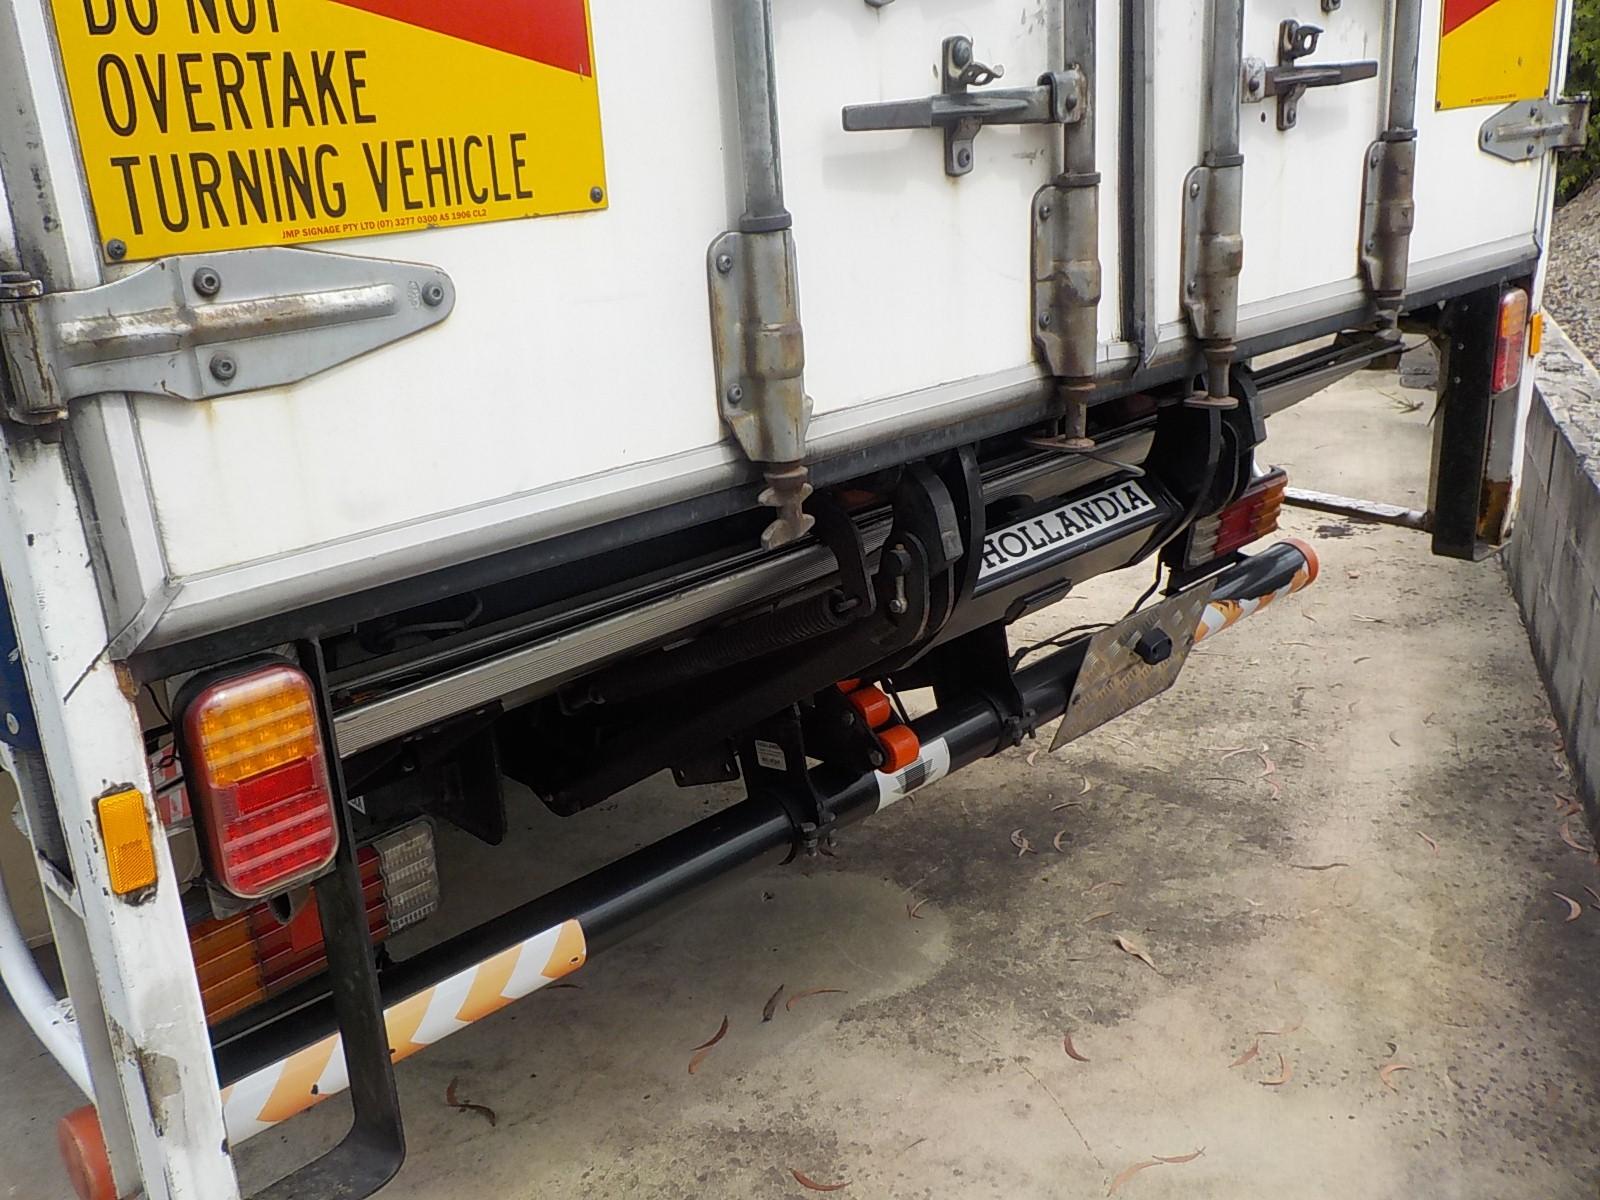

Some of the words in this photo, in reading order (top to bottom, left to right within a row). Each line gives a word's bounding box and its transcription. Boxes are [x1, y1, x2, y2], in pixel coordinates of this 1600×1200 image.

[97, 50, 377, 136] OVERTAKE
[111, 144, 346, 236] TURNING
[363, 133, 533, 213] VEHICLE
[282, 226, 300, 239] JMP
[302, 225, 341, 237] SIGNAGE
[342, 223, 359, 233] PTY
[360, 221, 375, 231] LTD
[376, 219, 394, 230] (07)
[395, 216, 415, 227] 3277
[417, 214, 438, 224] 0300
[439, 213, 450, 222] AS
[451, 210, 472, 220] 1906
[473, 208, 487, 218] CL2
[982, 485, 1150, 569] HOLLANDIA
